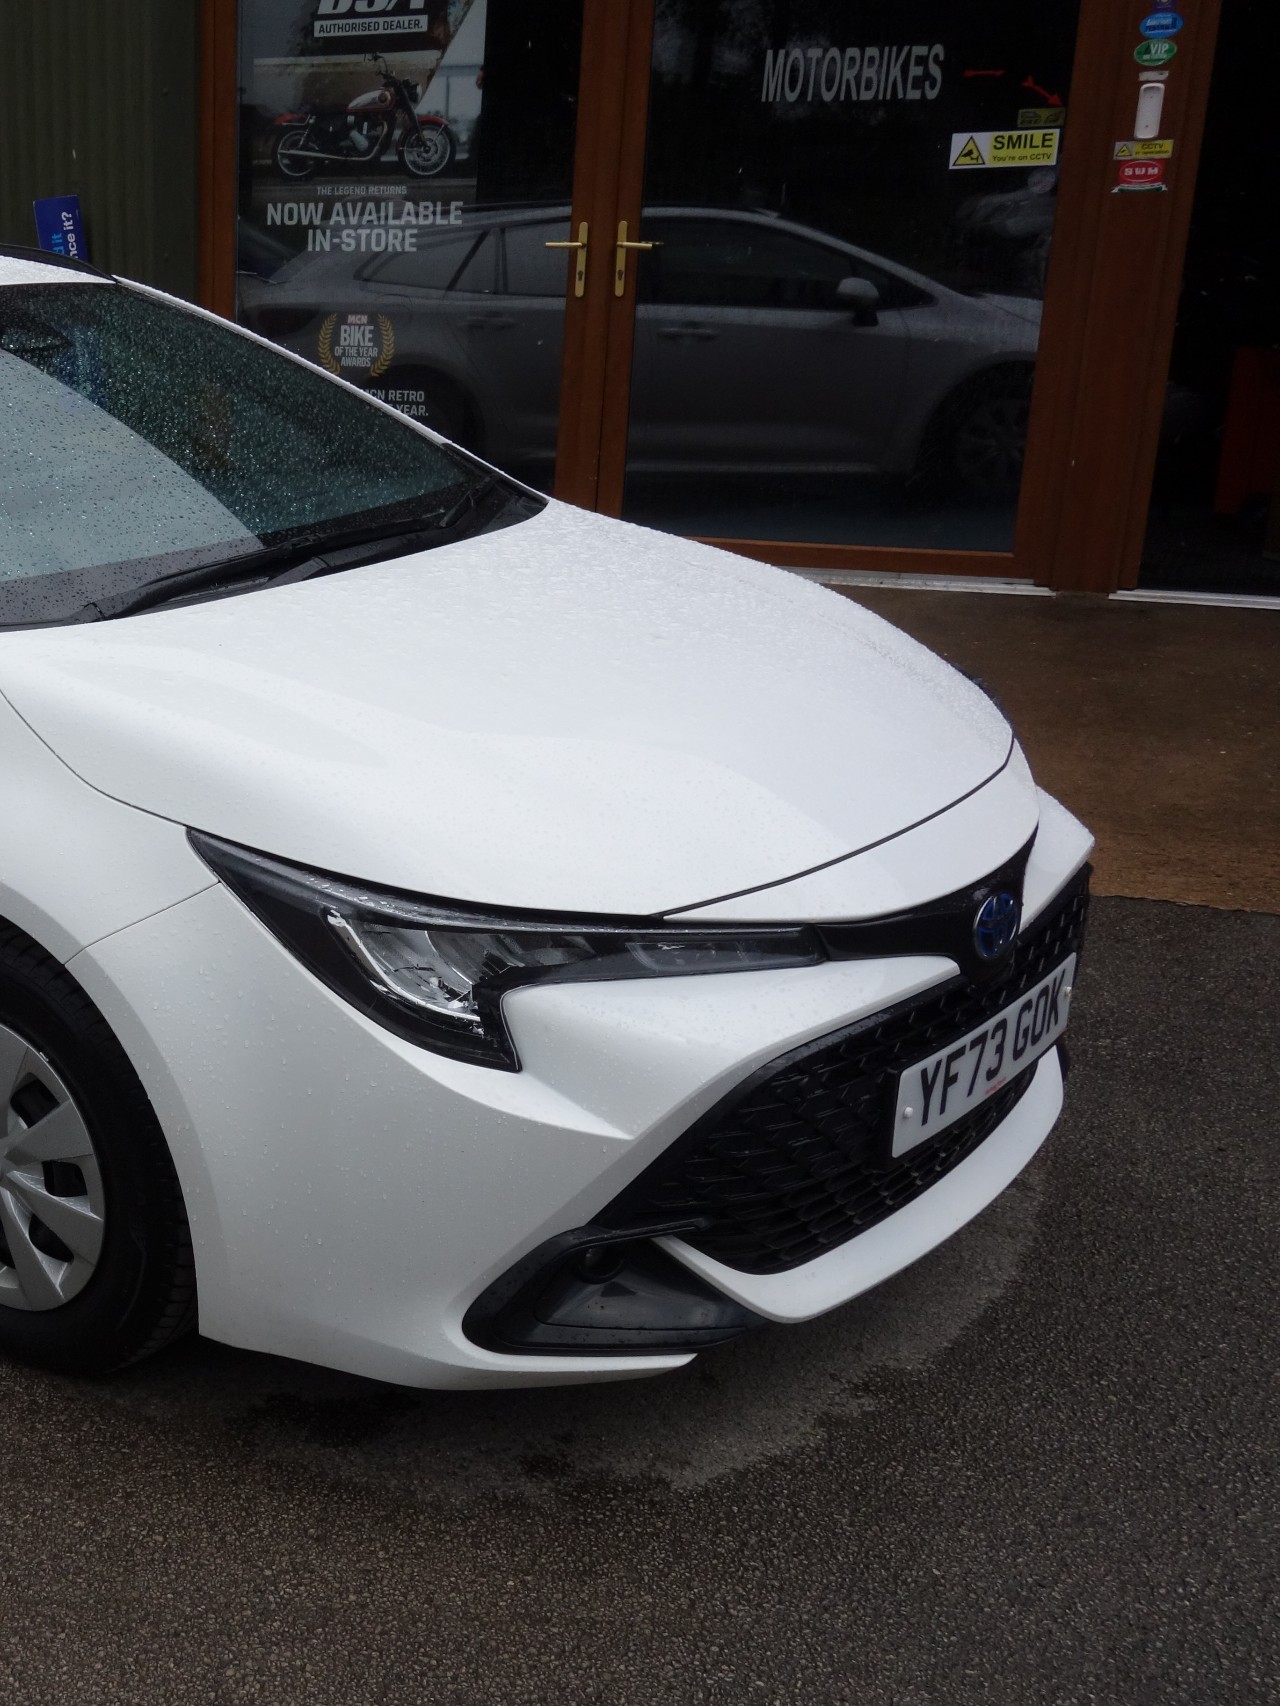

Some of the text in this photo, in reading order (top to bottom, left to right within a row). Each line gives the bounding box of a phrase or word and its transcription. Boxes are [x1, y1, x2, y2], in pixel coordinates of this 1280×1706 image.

[318, 19, 423, 33] AUTHORISED DEALER.
[761, 43, 945, 103] MOTORBIKES
[993, 133, 1054, 150] SMILE
[992, 154, 1016, 162] You're
[317, 185, 408, 195] THE LEGEND RETURNS
[61, 211, 74, 230] it?
[267, 201, 464, 226] NOW AVAILABLE
[307, 228, 418, 252] IN-STORE
[347, 314, 368, 324] MCN
[340, 325, 374, 346] BIKE
[334, 346, 378, 357] OF THE YEAR
[340, 357, 371, 367] AWARDS
[388, 390, 425, 402] RETRO
[920, 968, 1066, 1127] YF73 GOK
